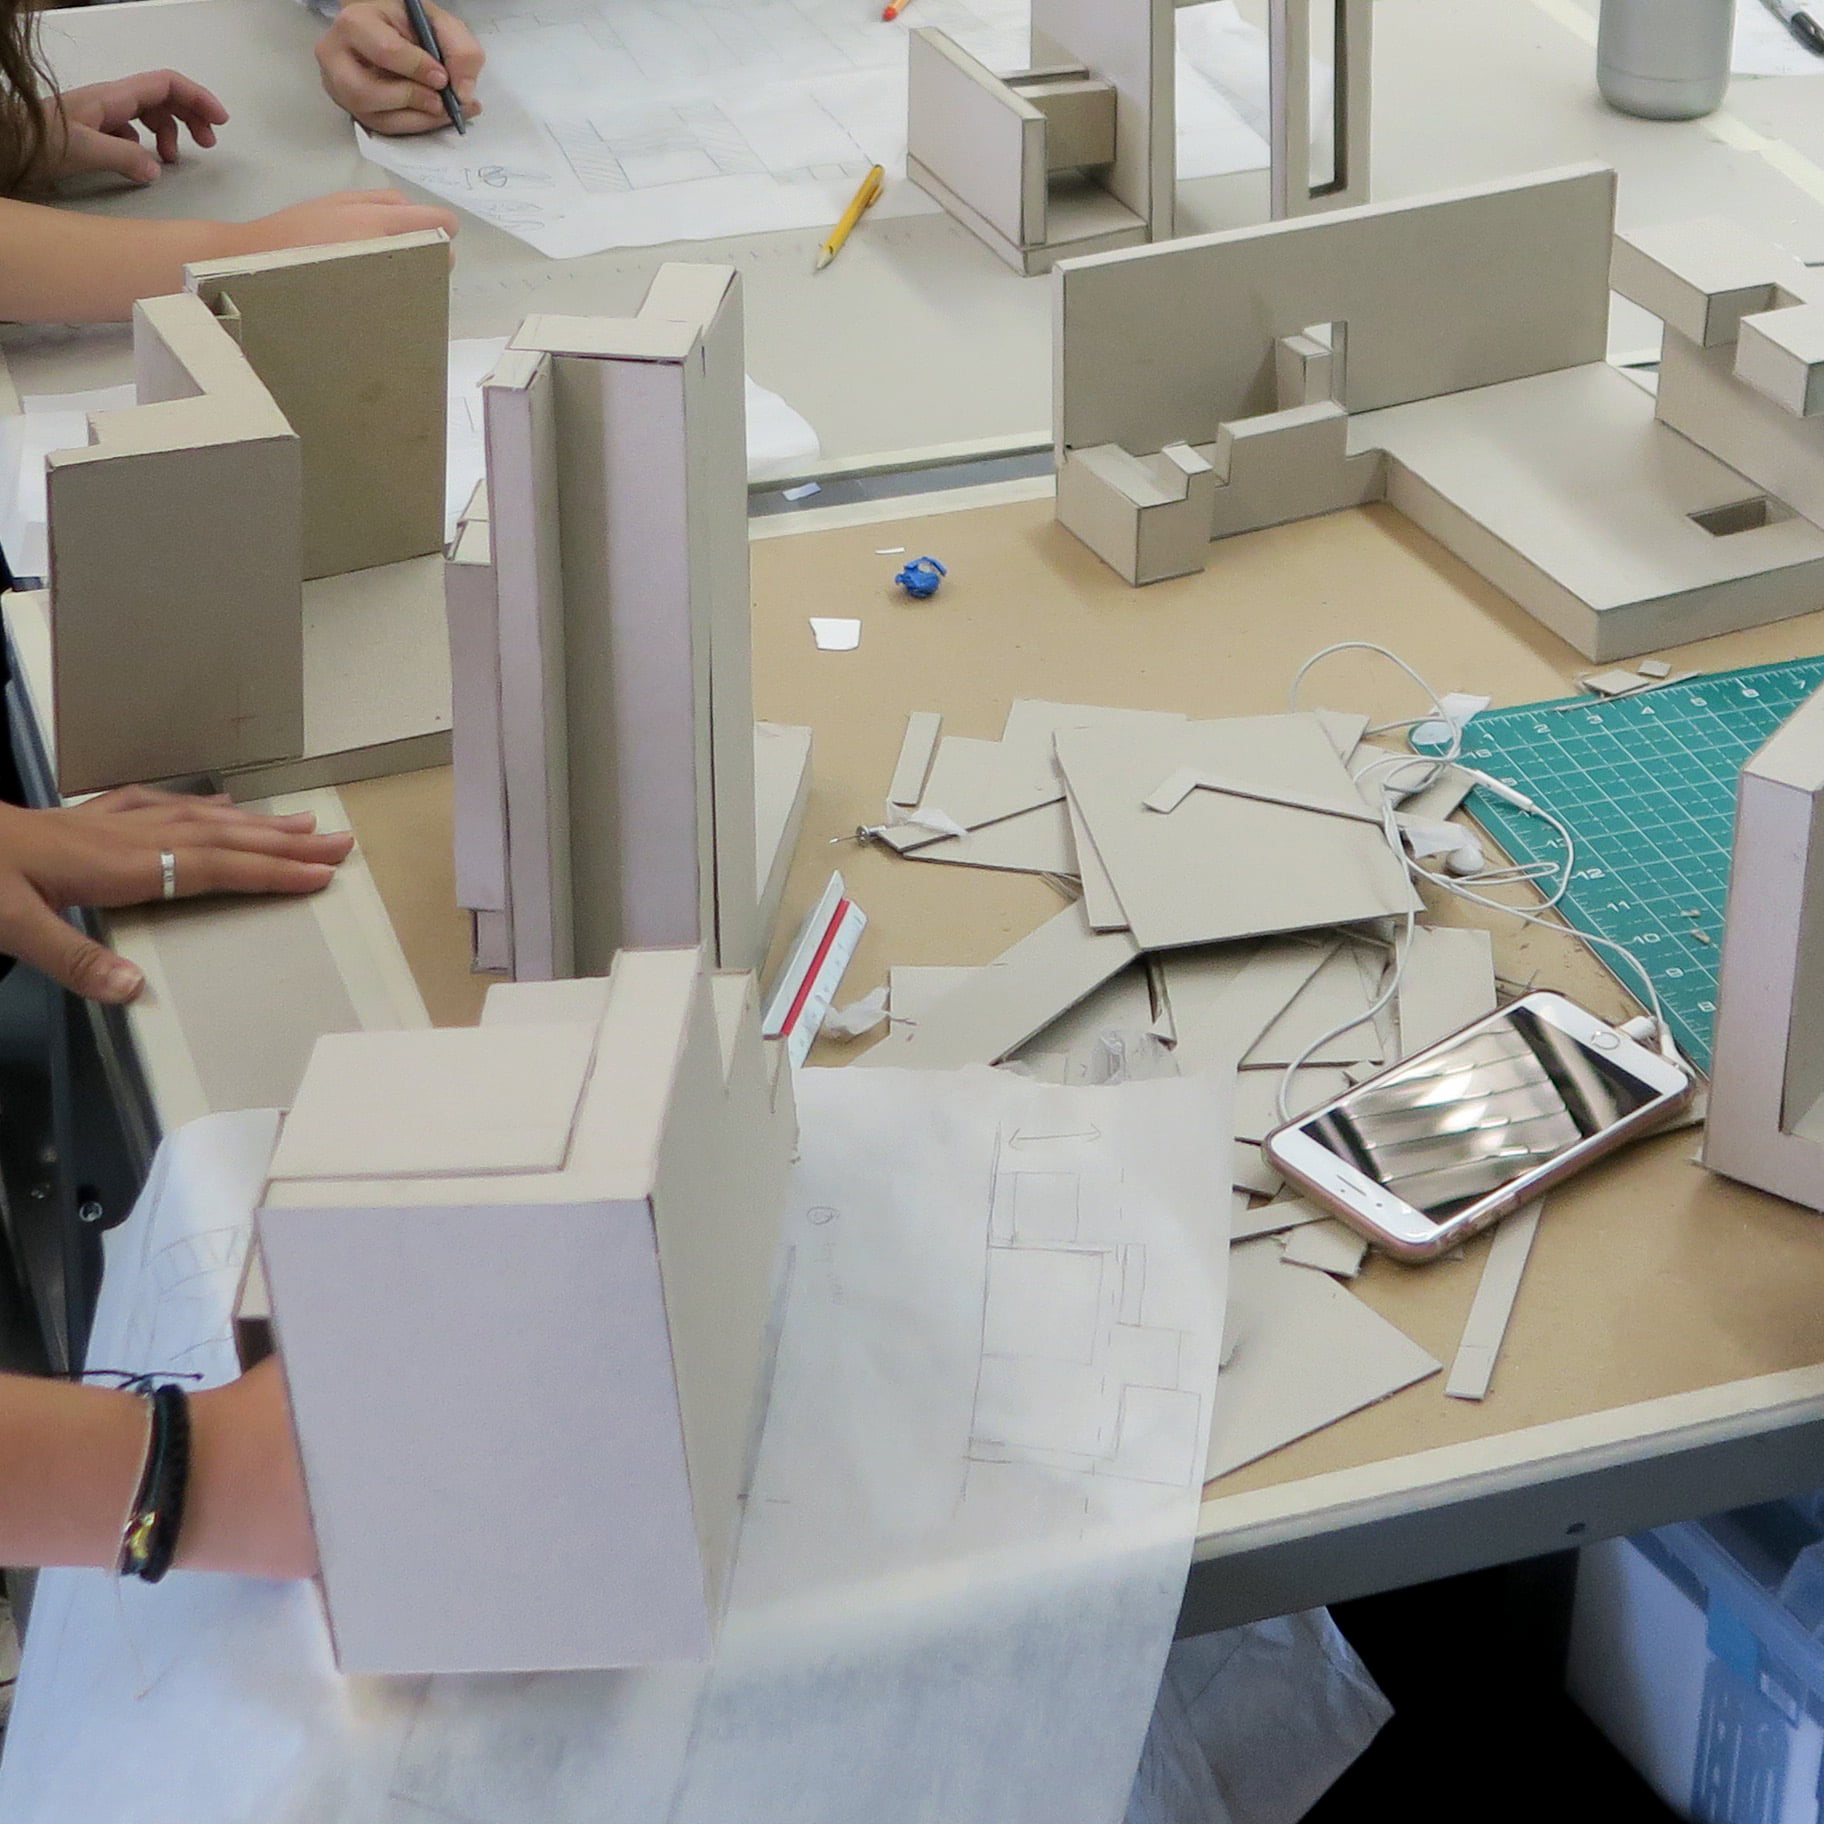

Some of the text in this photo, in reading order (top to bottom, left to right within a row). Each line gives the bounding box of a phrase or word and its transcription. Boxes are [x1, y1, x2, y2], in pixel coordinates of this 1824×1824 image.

[1533, 723, 1552, 734] 2
[1577, 868, 1606, 880] 12
[1607, 900, 1631, 912] 11
[1632, 932, 1661, 945] 10
